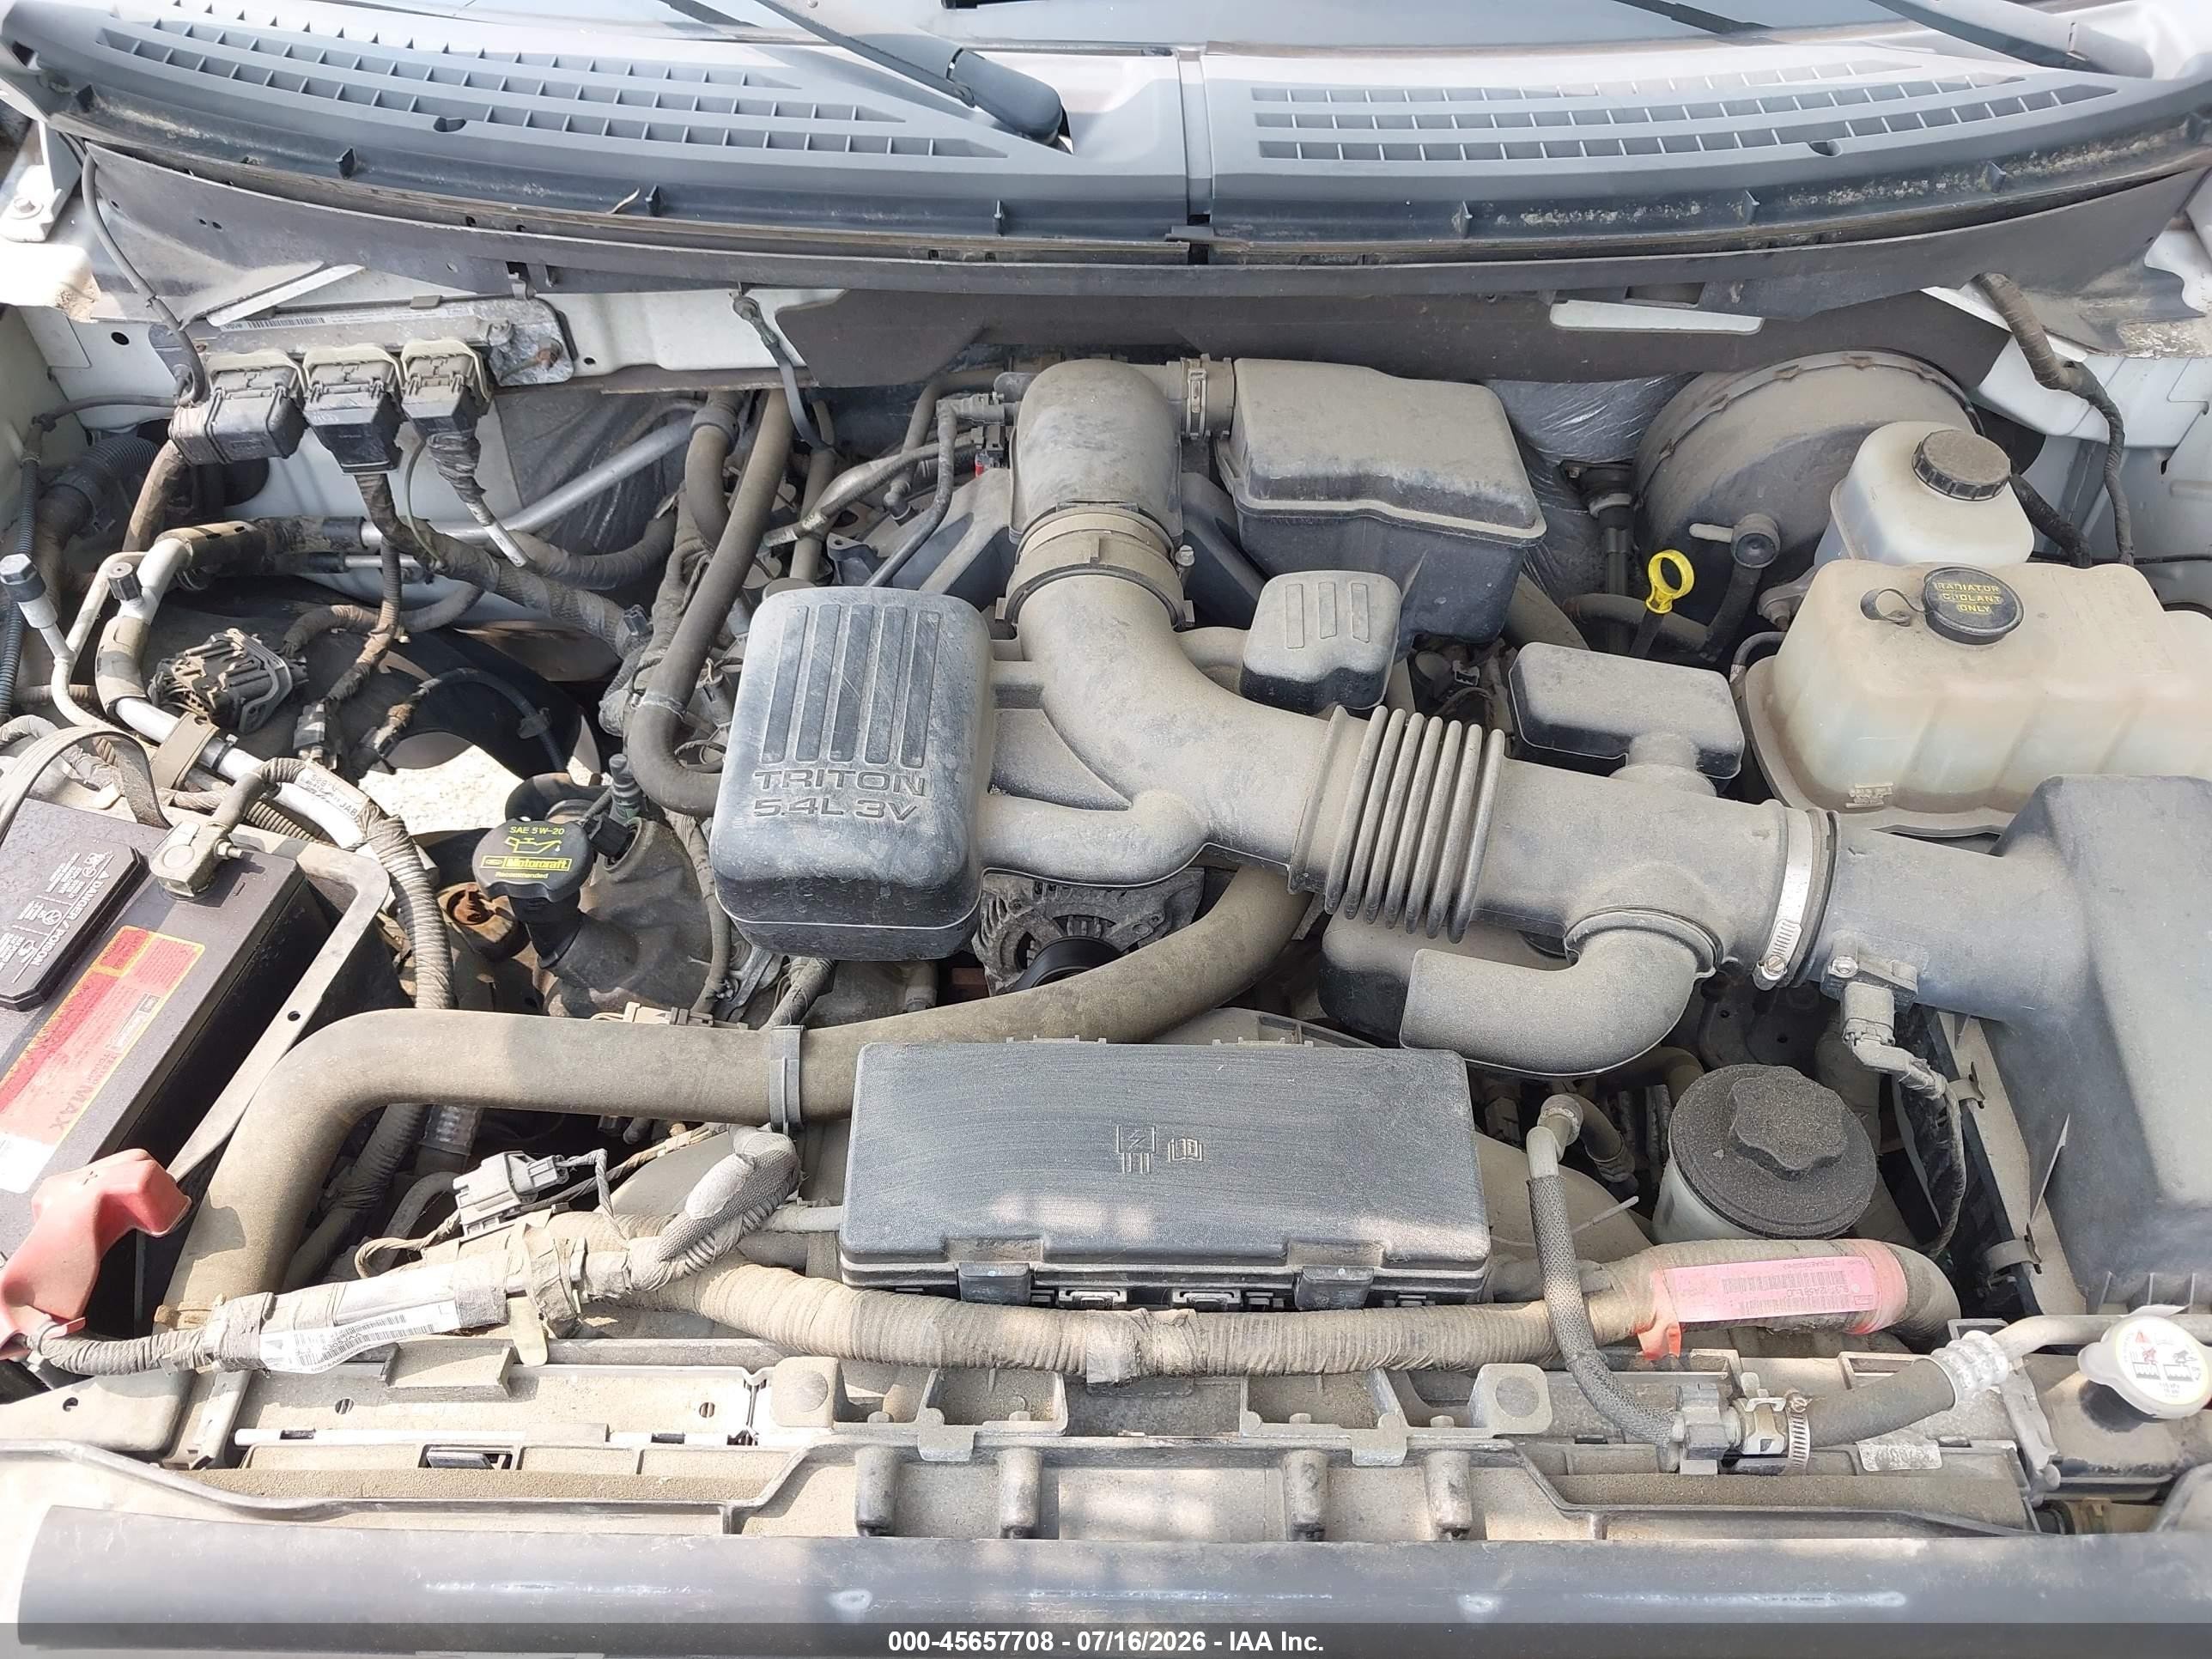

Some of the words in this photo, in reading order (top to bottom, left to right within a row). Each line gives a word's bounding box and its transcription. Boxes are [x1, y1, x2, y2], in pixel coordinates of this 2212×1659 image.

[1936, 582, 2000, 592] RADIATOR
[754, 769, 927, 797] TRITON
[753, 797, 844, 817] 5.4L
[855, 799, 919, 821] 3V
[509, 826, 530, 835] SAE
[532, 826, 565, 836] 5W-20
[507, 858, 568, 869] Motorcraft
[67, 880, 105, 921] DANGER
[30, 928, 67, 967] POISON
[49, 1085, 94, 1130] MAX
